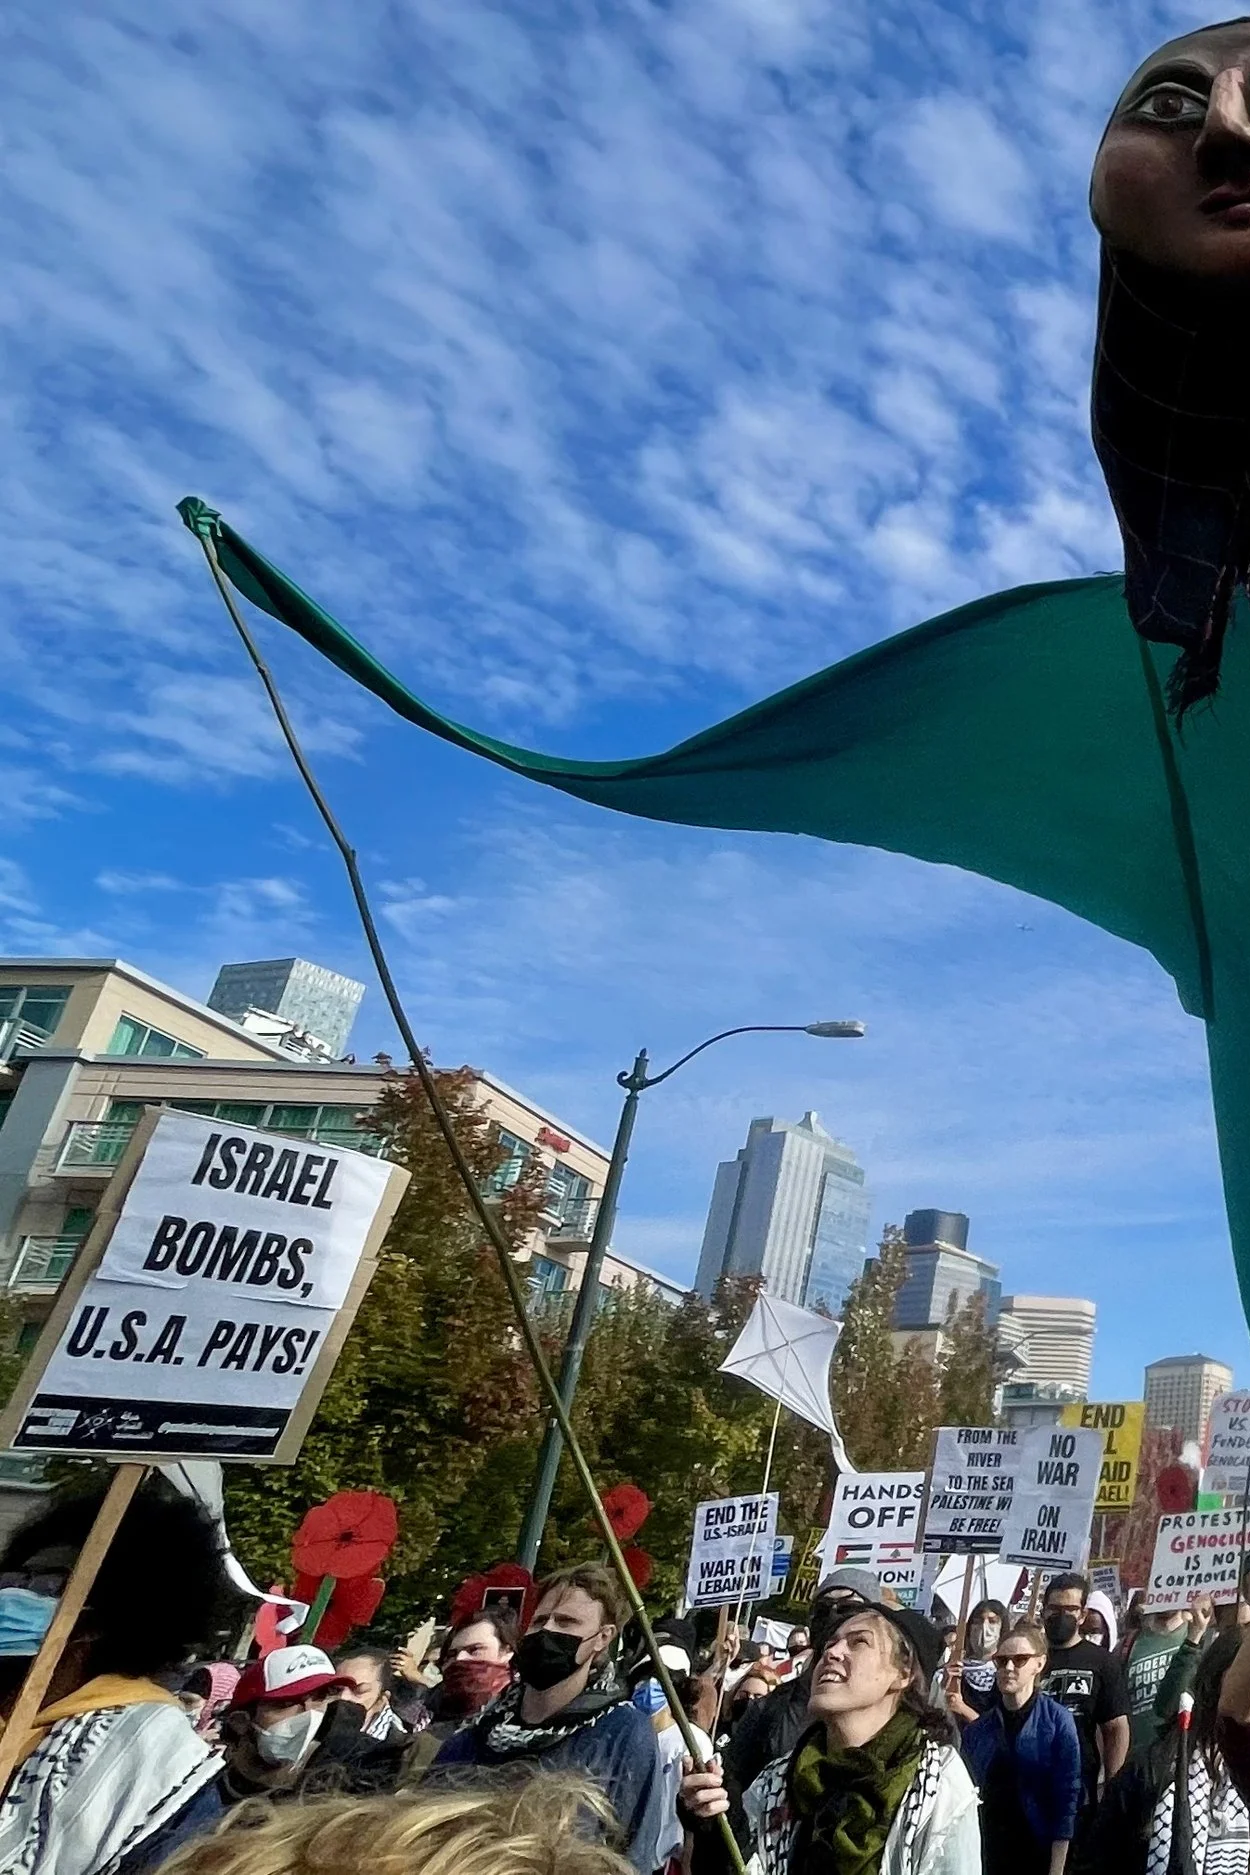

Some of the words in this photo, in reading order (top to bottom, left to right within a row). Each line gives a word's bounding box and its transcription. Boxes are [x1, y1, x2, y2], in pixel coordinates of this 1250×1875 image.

[192, 1133, 339, 1210] ISRAEL
[142, 1215, 314, 1298] BOMBS,
[66, 1305, 188, 1367] U.S.A.
[197, 1320, 321, 1376] PAYS!
[1080, 1405, 1125, 1429] END
[957, 1429, 992, 1444] FROM
[996, 1430, 1017, 1445] THE
[1049, 1433, 1076, 1459] NO
[967, 1452, 1001, 1468] RIVER
[949, 1475, 963, 1491] TO
[967, 1475, 989, 1491] THE
[992, 1476, 1014, 1492] SEA
[1037, 1461, 1080, 1487] WAR
[1099, 1461, 1131, 1483] AID
[842, 1483, 925, 1501] HANDS
[930, 1495, 994, 1510] PALESTINE
[996, 1496, 1013, 1511] WI
[705, 1505, 736, 1527] END
[741, 1500, 769, 1521] THE
[848, 1506, 915, 1529] OFF
[949, 1517, 965, 1533] BE
[967, 1518, 1000, 1533] FREE!
[1037, 1504, 1061, 1528] ON
[1021, 1528, 1067, 1554] IRAN!
[700, 1559, 736, 1579] WAR
[740, 1555, 763, 1574] ON
[1184, 1554, 1201, 1571] IS
[697, 1574, 760, 1596] LEBANON
[1154, 1569, 1237, 1588] CONTROVER
[1129, 1655, 1167, 1679] PODER
[1136, 1667, 1169, 1688] PUEB
